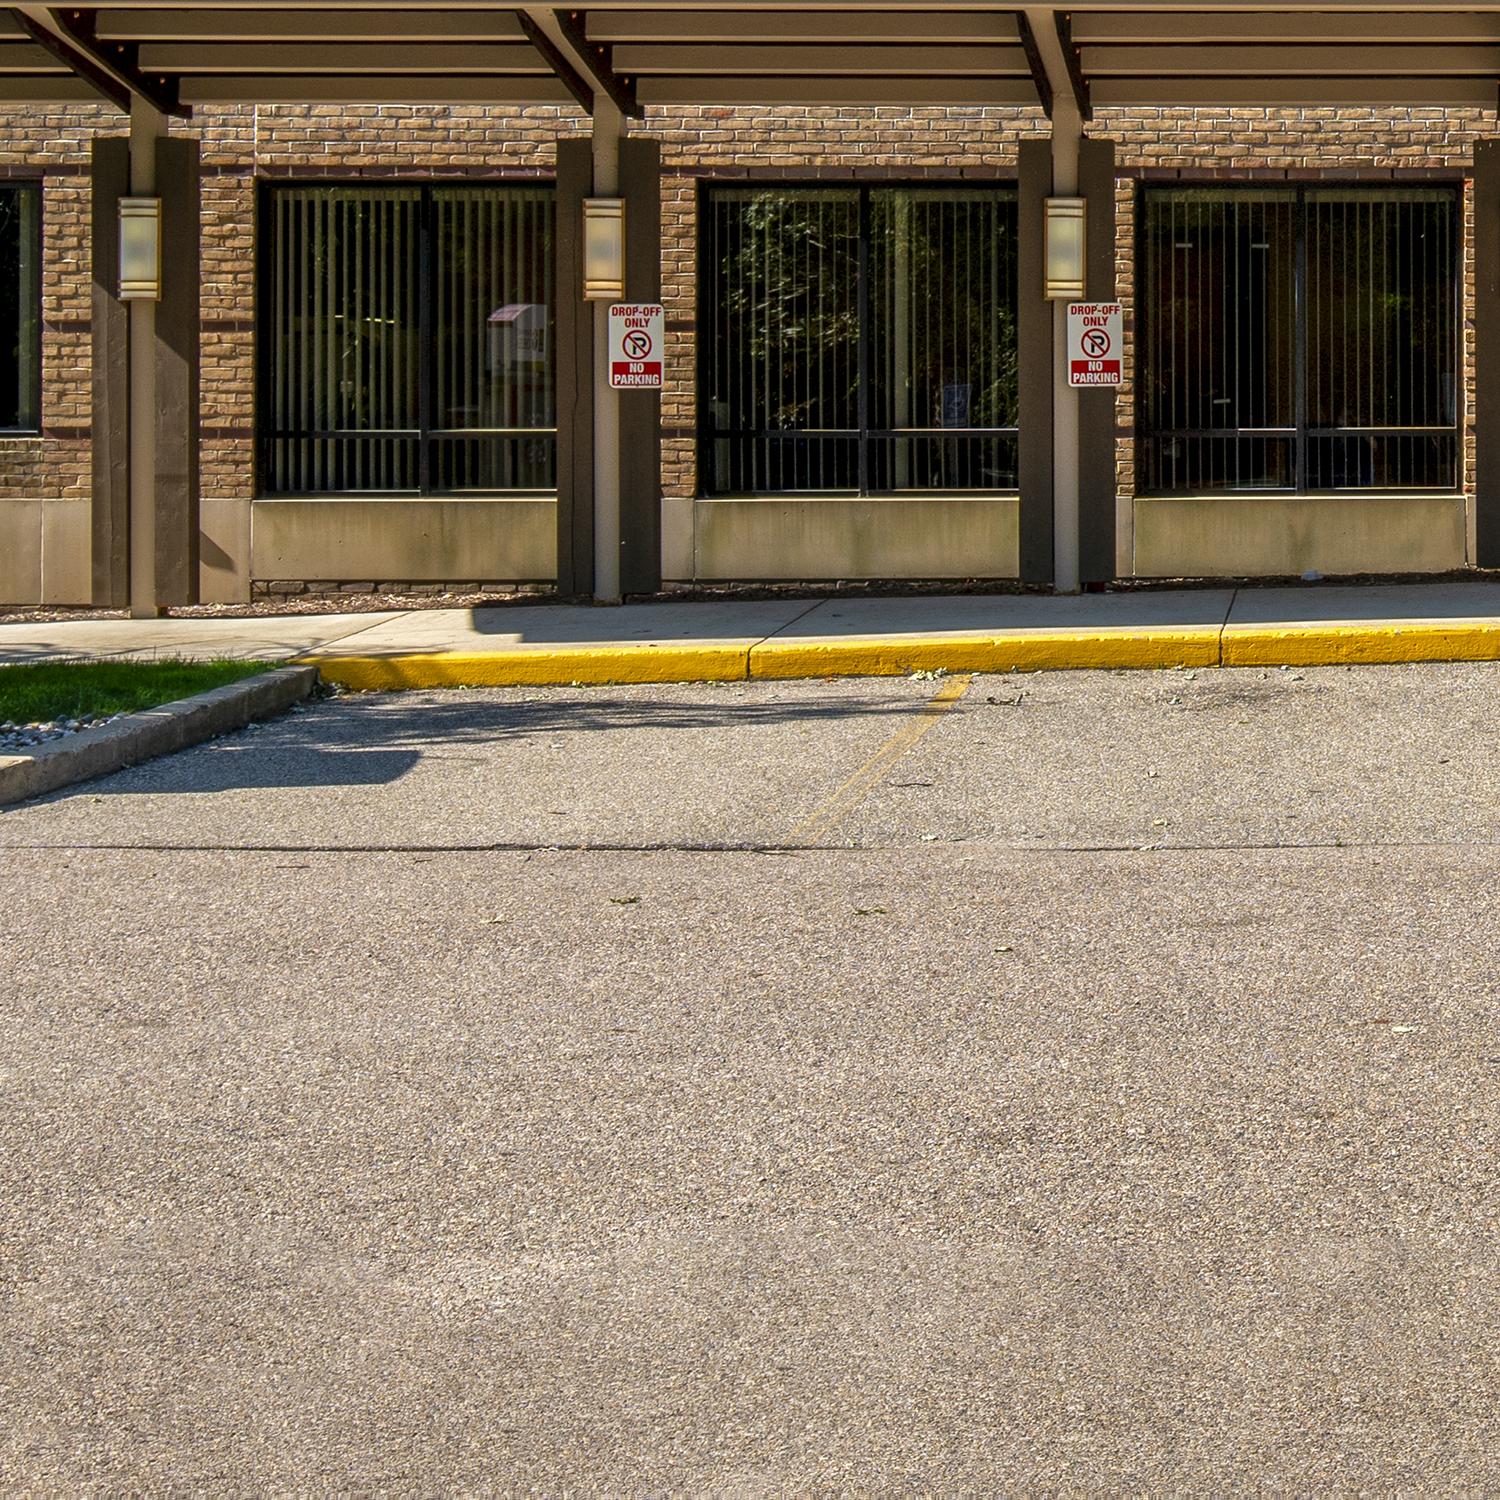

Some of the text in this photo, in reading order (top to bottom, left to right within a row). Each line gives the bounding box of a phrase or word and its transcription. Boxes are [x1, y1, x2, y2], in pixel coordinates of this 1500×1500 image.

[611, 306, 662, 317] DROP-OFF
[1070, 305, 1120, 315] DROP-OFF
[624, 318, 650, 328] ONLY
[1082, 316, 1108, 327] ONLY
[629, 362, 644, 373] NO
[1088, 361, 1103, 372] NO
[614, 374, 659, 385] PARKING
[1073, 372, 1118, 383] PARKING
